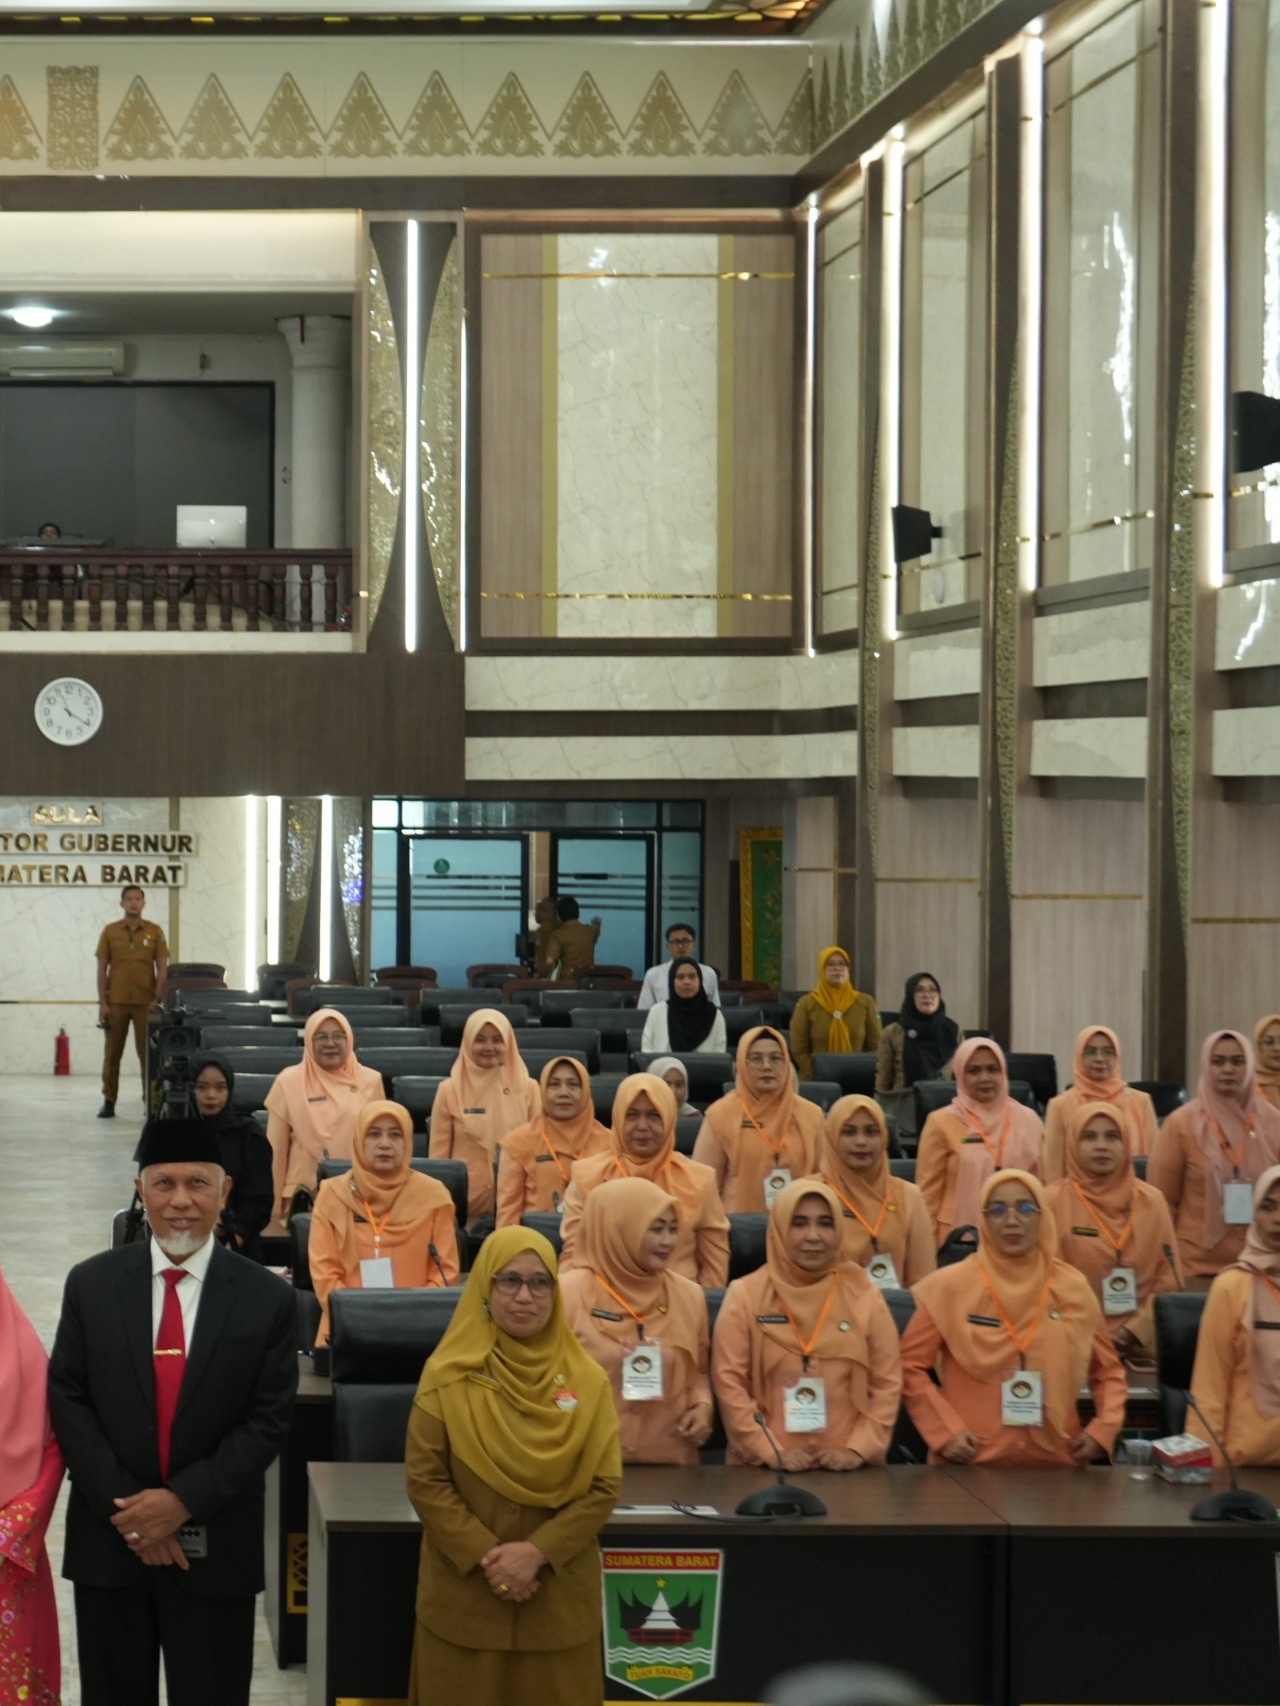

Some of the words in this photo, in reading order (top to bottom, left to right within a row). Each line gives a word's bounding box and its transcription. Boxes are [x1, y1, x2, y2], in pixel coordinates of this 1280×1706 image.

[32, 804, 102, 824] AULA
[59, 832, 194, 853] GUBERNUR
[100, 864, 183, 884] BARAT
[605, 1555, 673, 1567] SUMATERA
[676, 1555, 718, 1567] BARAT
[630, 1668, 653, 1678] TUAH
